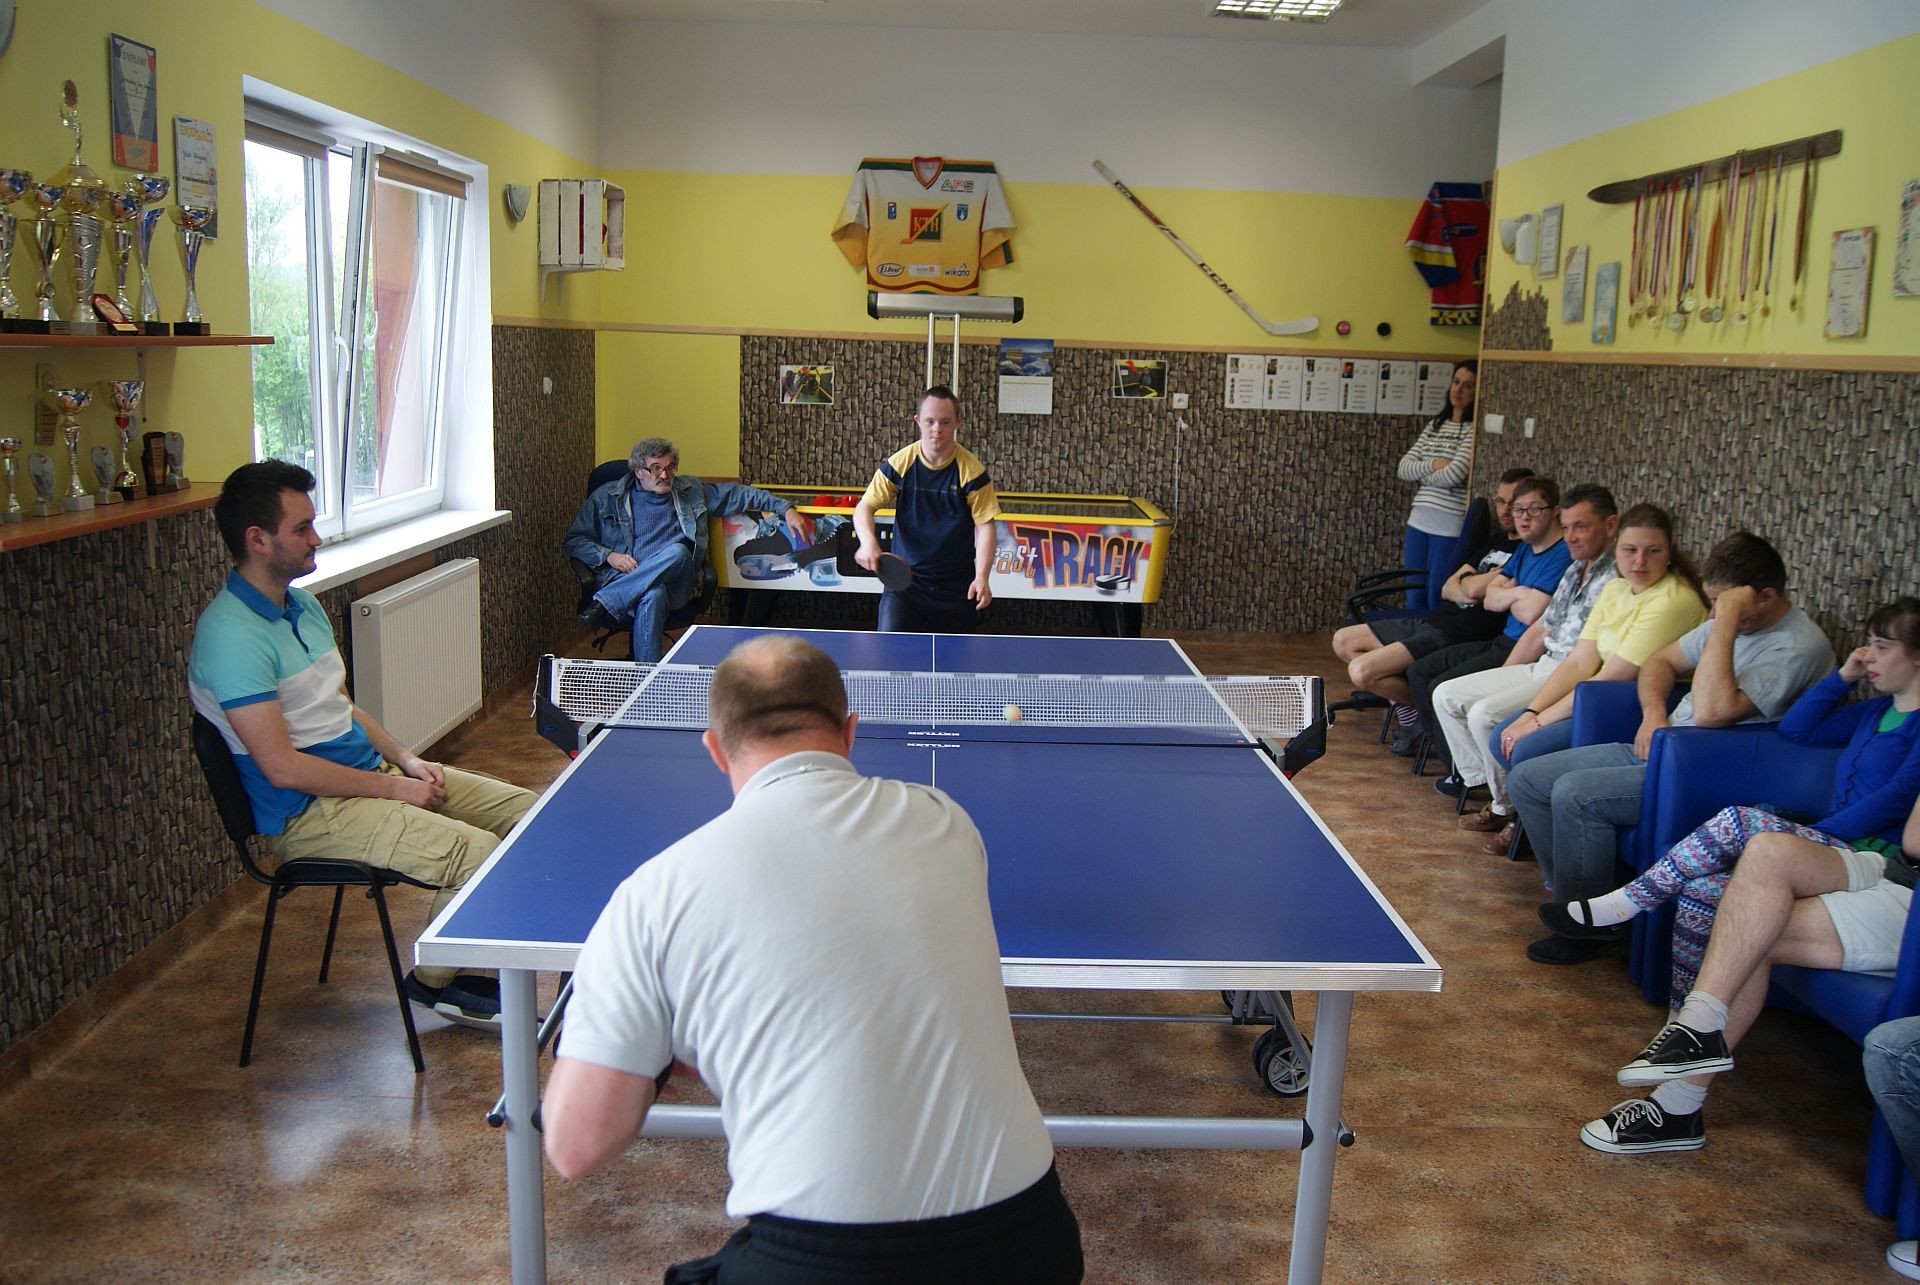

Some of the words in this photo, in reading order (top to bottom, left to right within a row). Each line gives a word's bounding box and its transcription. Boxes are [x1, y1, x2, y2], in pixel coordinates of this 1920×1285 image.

[940, 179, 974, 190] APS
[913, 216, 939, 232] KTH
[1199, 262, 1232, 293] CCM
[1013, 523, 1145, 589] TRACK
